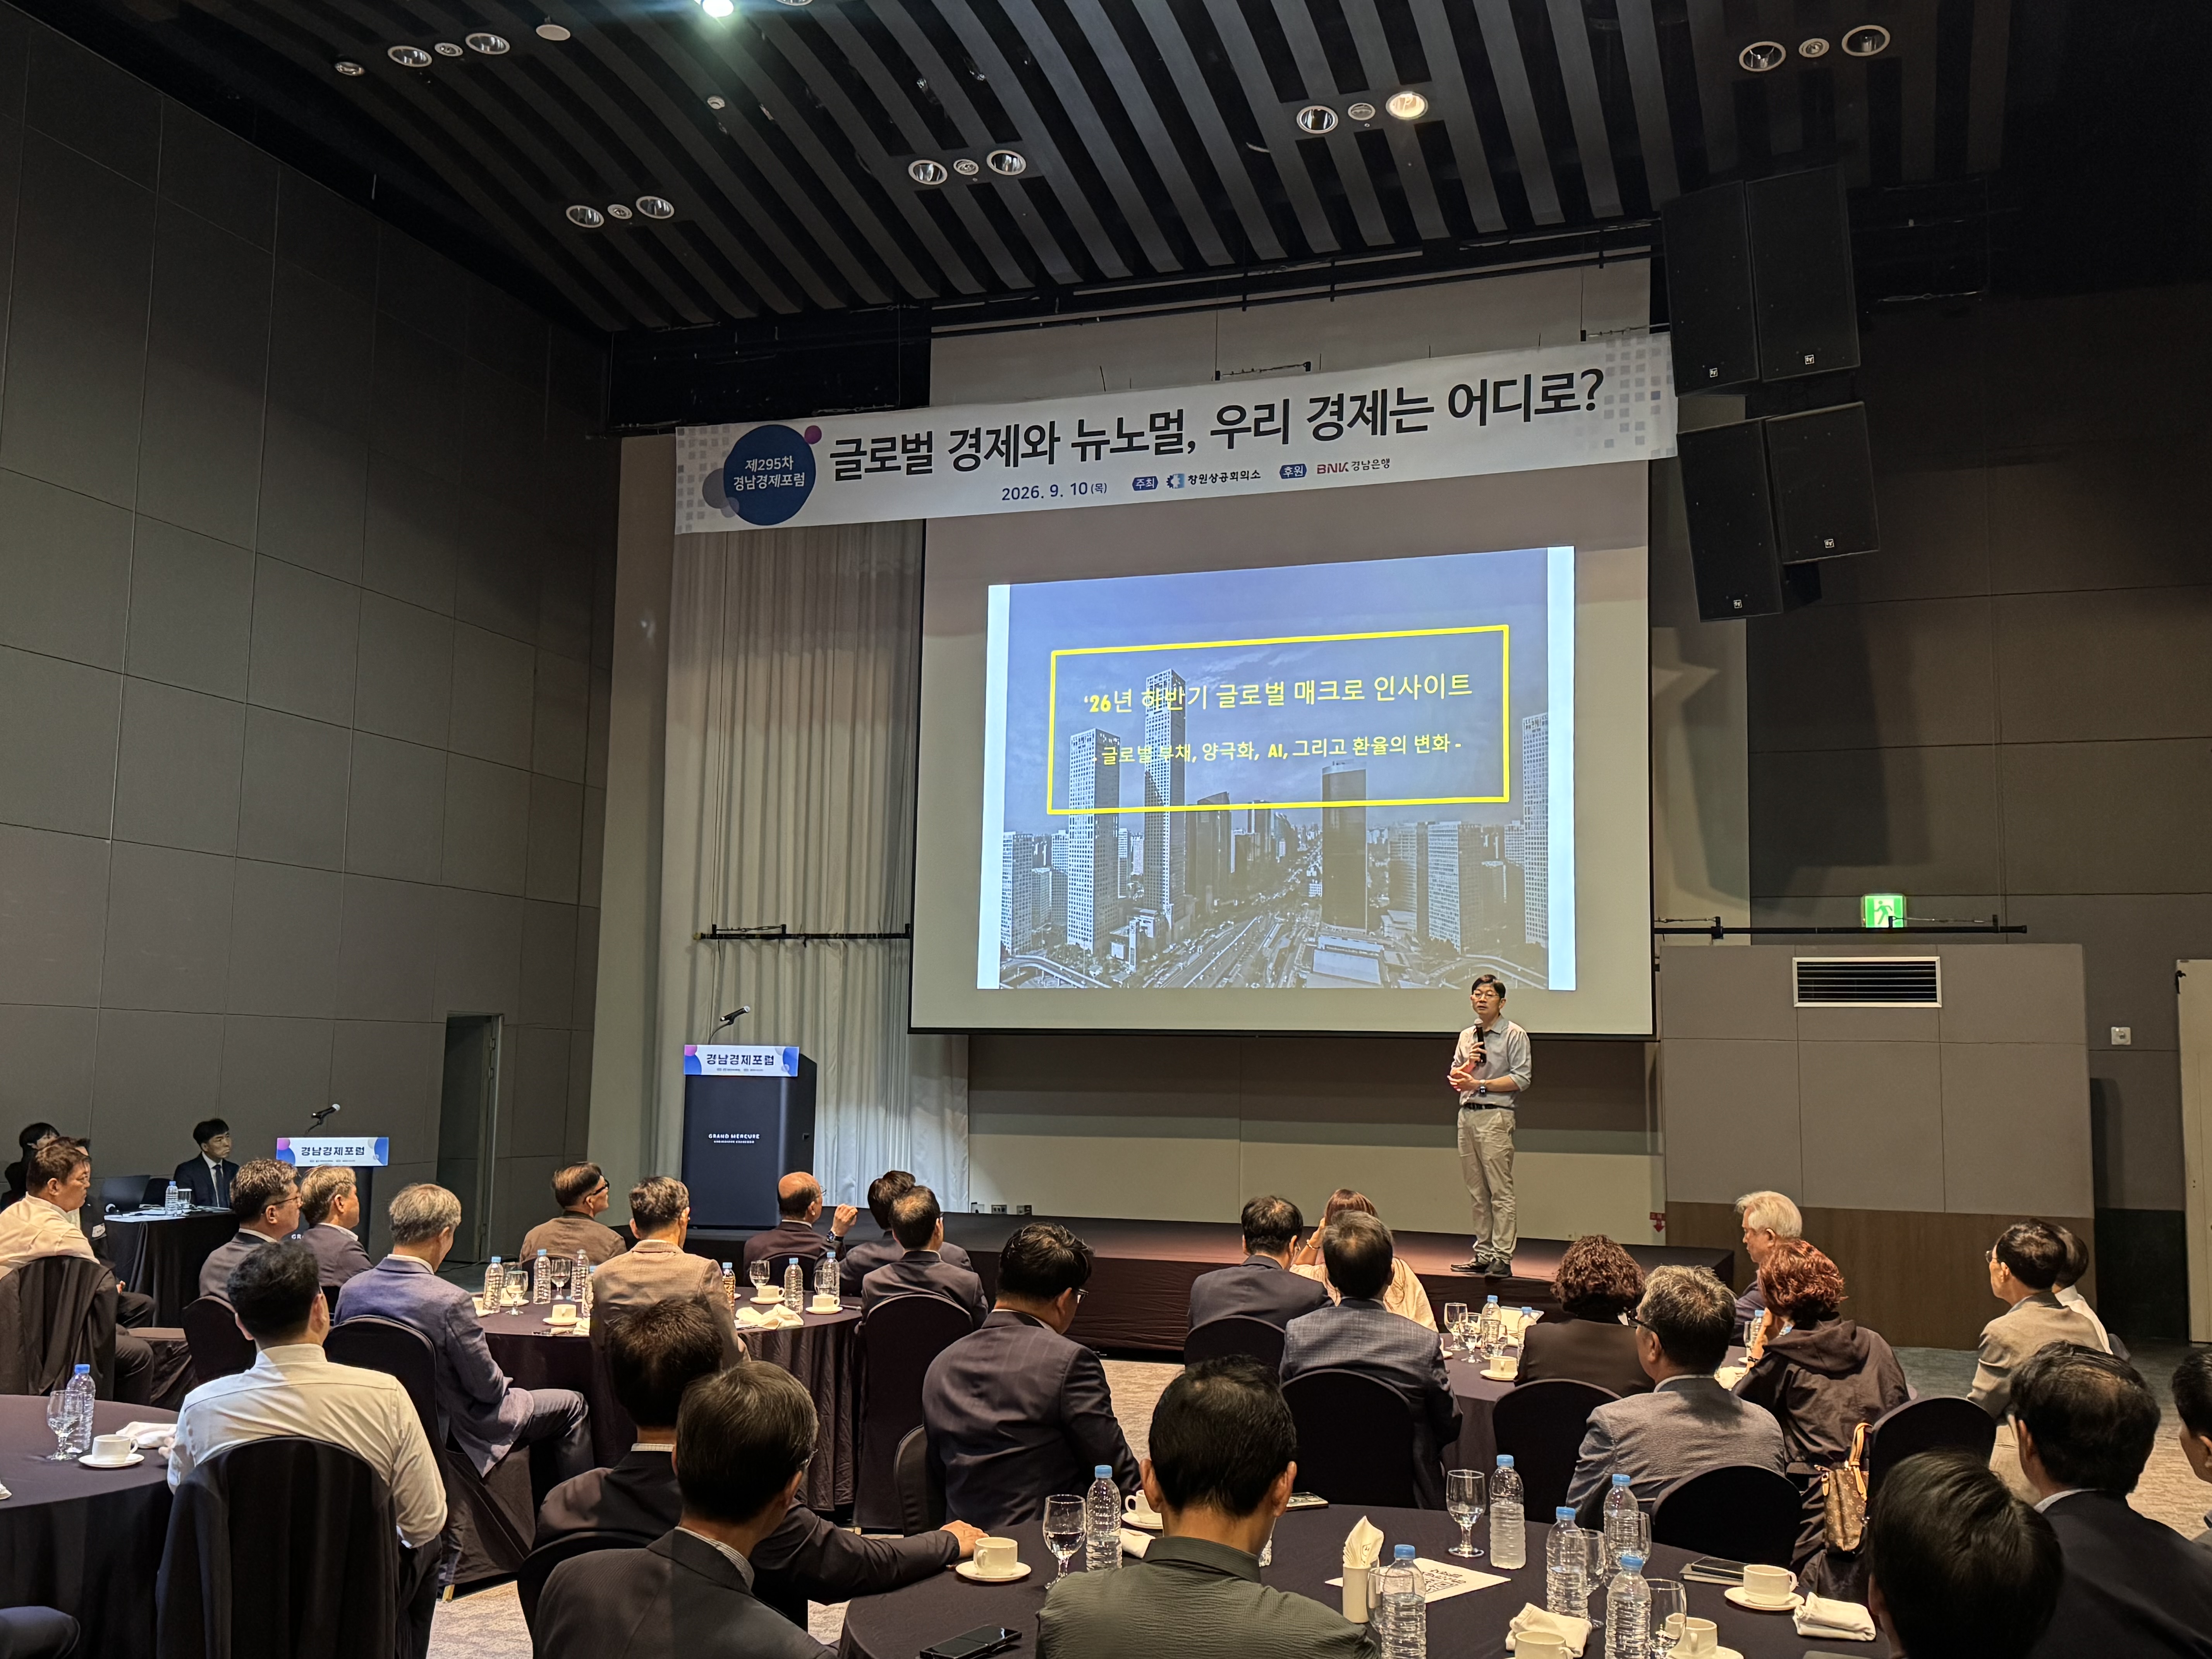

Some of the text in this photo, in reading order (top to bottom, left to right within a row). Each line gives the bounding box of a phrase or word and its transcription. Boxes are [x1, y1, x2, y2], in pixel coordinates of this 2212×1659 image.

[830, 368, 1604, 481] 글로벌 경제와 뉴노멀, 우리 경제는 어디로?
[745, 455, 793, 472] 제295차
[1283, 465, 1303, 477] 후원
[733, 472, 805, 491] 경남경제포럼
[1135, 478, 1154, 489] 주최
[1002, 486, 1044, 500] 2026.
[1050, 484, 1063, 497] 9.
[1141, 685, 1207, 711] 하반기
[1216, 681, 1284, 708] 글로벌
[1295, 679, 1365, 705] 매크로
[1374, 673, 1472, 701] 인사이트
[1101, 745, 1152, 765] 글로벌
[1160, 744, 1197, 763] 부채,
[1202, 741, 1259, 761] 양극화,
[1268, 744, 1288, 759] AI,
[1292, 738, 1347, 757] 그리고
[1353, 735, 1406, 756] 환율의
[1414, 733, 1450, 754] 변화
[707, 1054, 774, 1065] 경남경제포럼
[301, 1146, 364, 1156] 경남경제포럼
